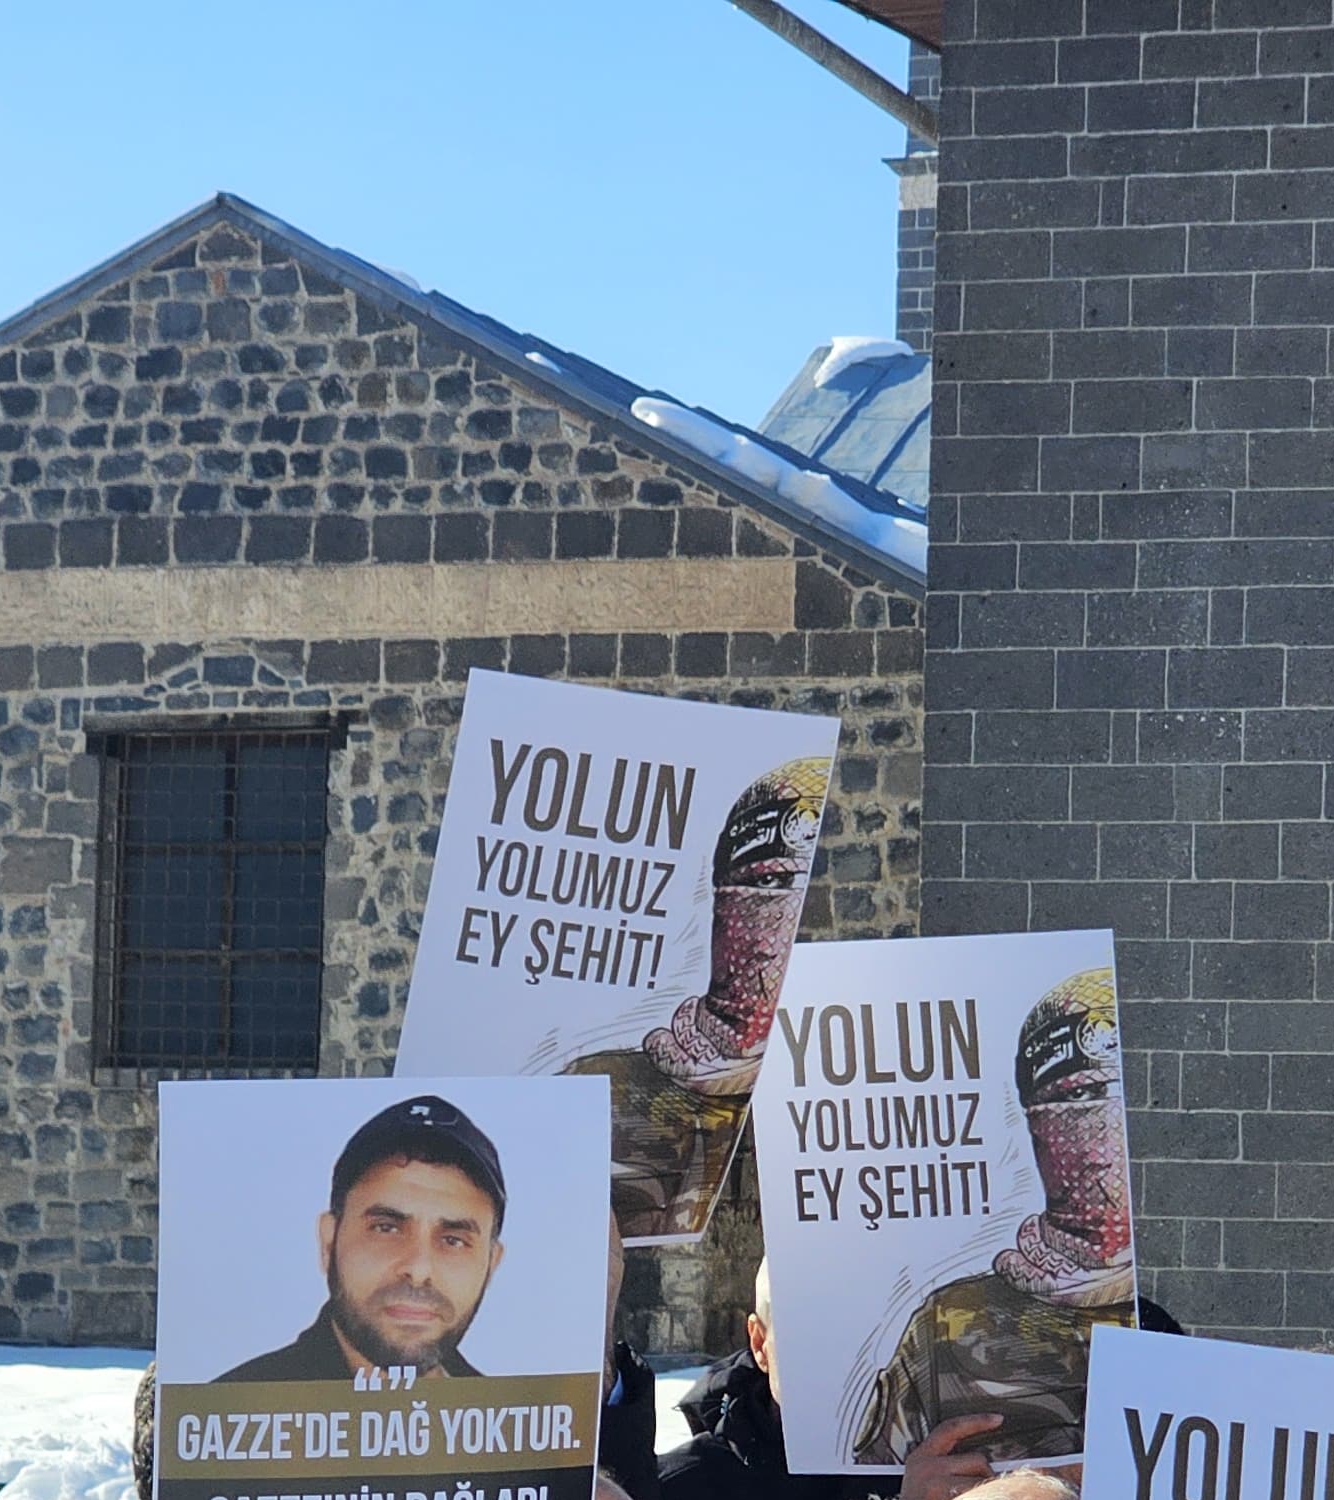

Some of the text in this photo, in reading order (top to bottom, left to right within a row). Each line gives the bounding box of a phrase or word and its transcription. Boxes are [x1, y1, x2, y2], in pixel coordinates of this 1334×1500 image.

[490, 738, 696, 850] YOLUN
[477, 836, 675, 917] YOLUMUZ
[455, 907, 665, 989] EY ŞEHİT!
[776, 999, 981, 1087] YOLUN
[787, 1093, 983, 1153] YOLUMUZ
[794, 1153, 990, 1231] EY ŞEHİT!
[177, 1400, 581, 1461] GAZZE'DE DAĞ YOKTUR.
